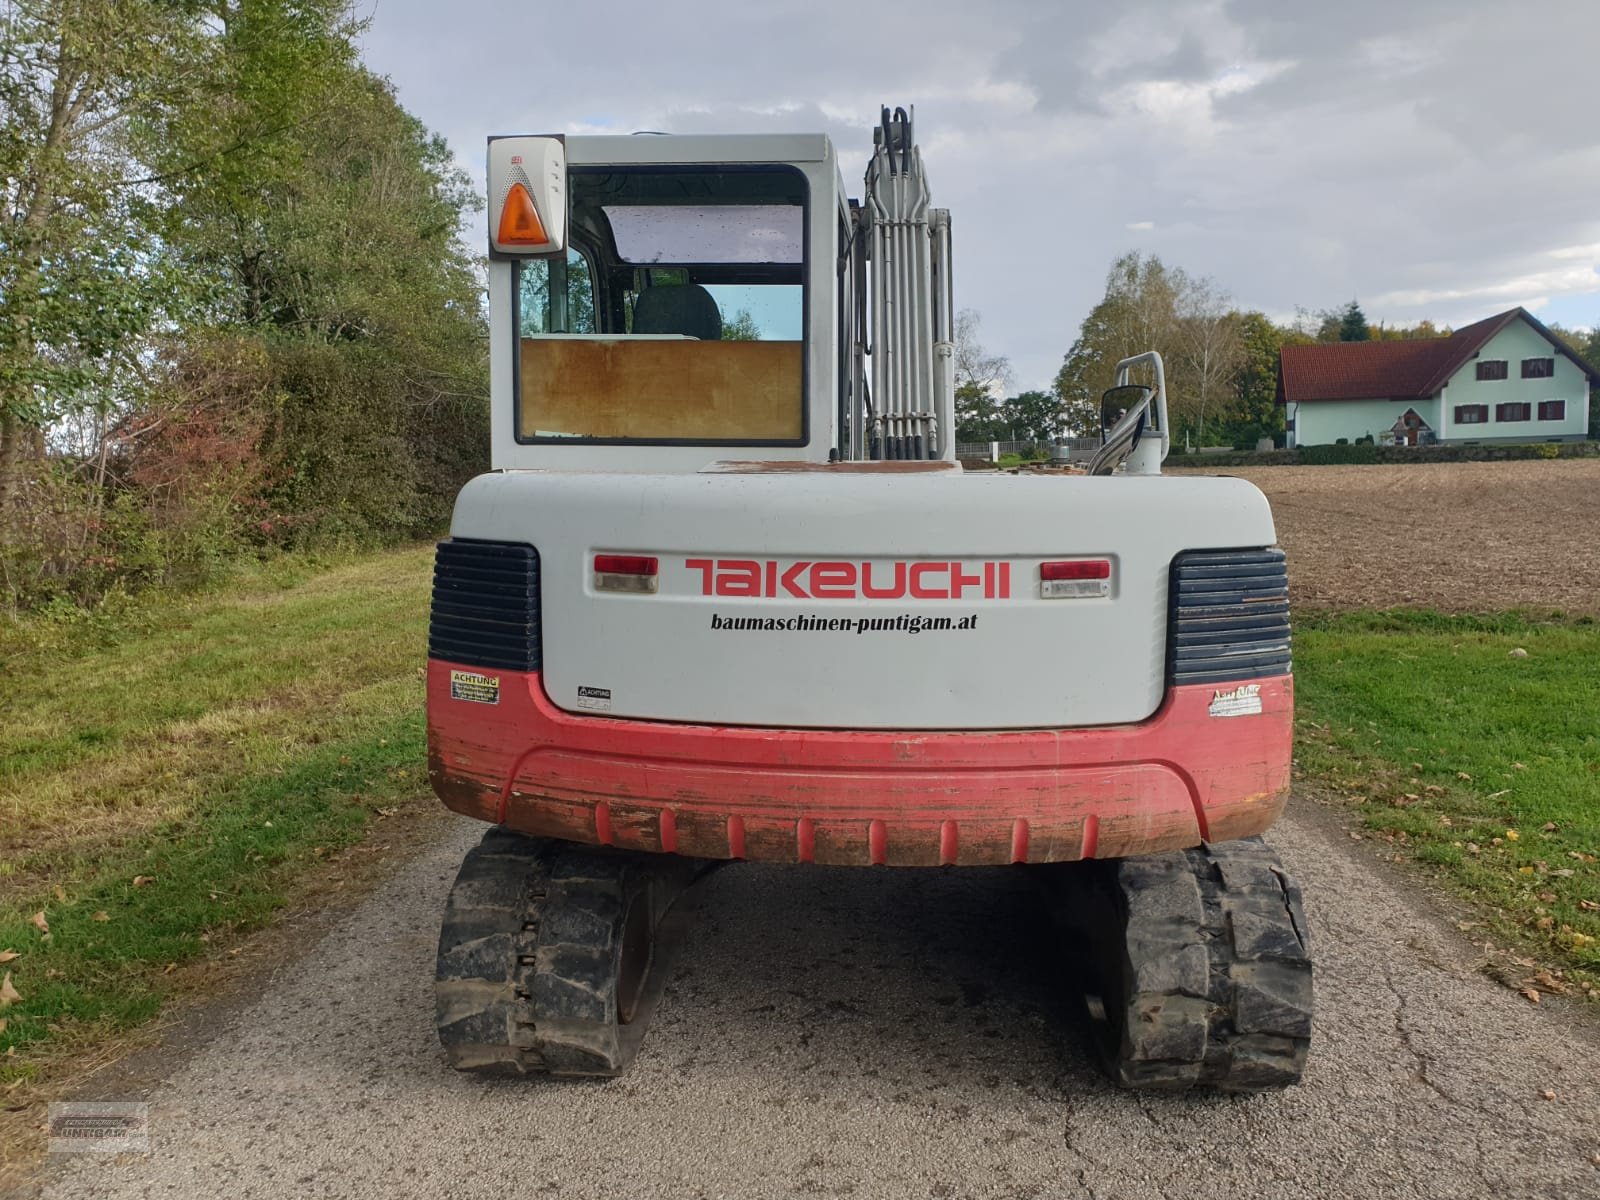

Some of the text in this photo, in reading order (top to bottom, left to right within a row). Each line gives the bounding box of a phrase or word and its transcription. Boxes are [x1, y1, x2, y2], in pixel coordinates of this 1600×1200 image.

[685, 558, 1010, 600] TAKEUCHI
[711, 614, 978, 634] baumaschinen-puntigam.at
[454, 673, 497, 686] ACHTUNG
